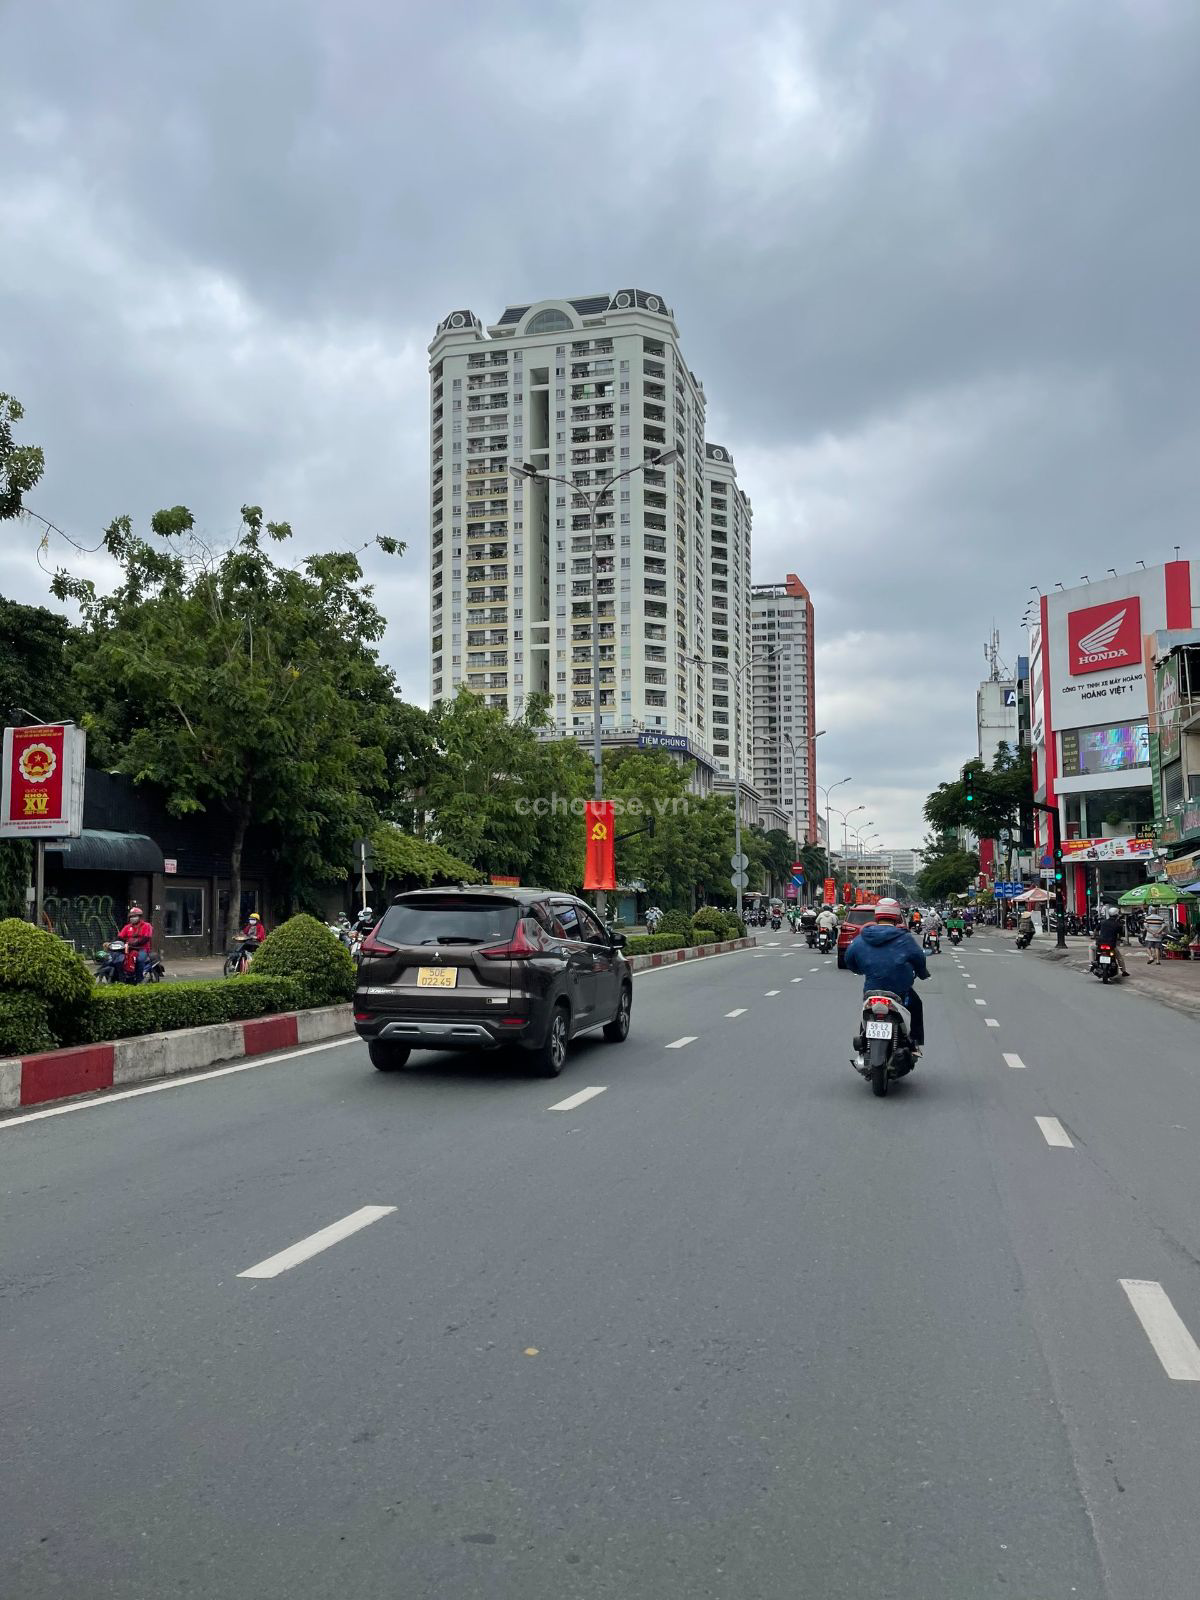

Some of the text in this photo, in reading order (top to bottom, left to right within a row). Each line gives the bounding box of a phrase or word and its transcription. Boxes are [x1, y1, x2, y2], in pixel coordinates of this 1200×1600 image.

[1078, 649, 1129, 664] HONDA
[1062, 686, 1077, 694] CÔNG
[1109, 677, 1121, 685] MÁY
[1122, 673, 1143, 683] HOÀNG
[1081, 684, 1134, 700] HOÀNG VIỆT 1
[641, 735, 659, 745] TIÊM
[23, 797, 50, 811] XV
[429, 968, 446, 977] 50E
